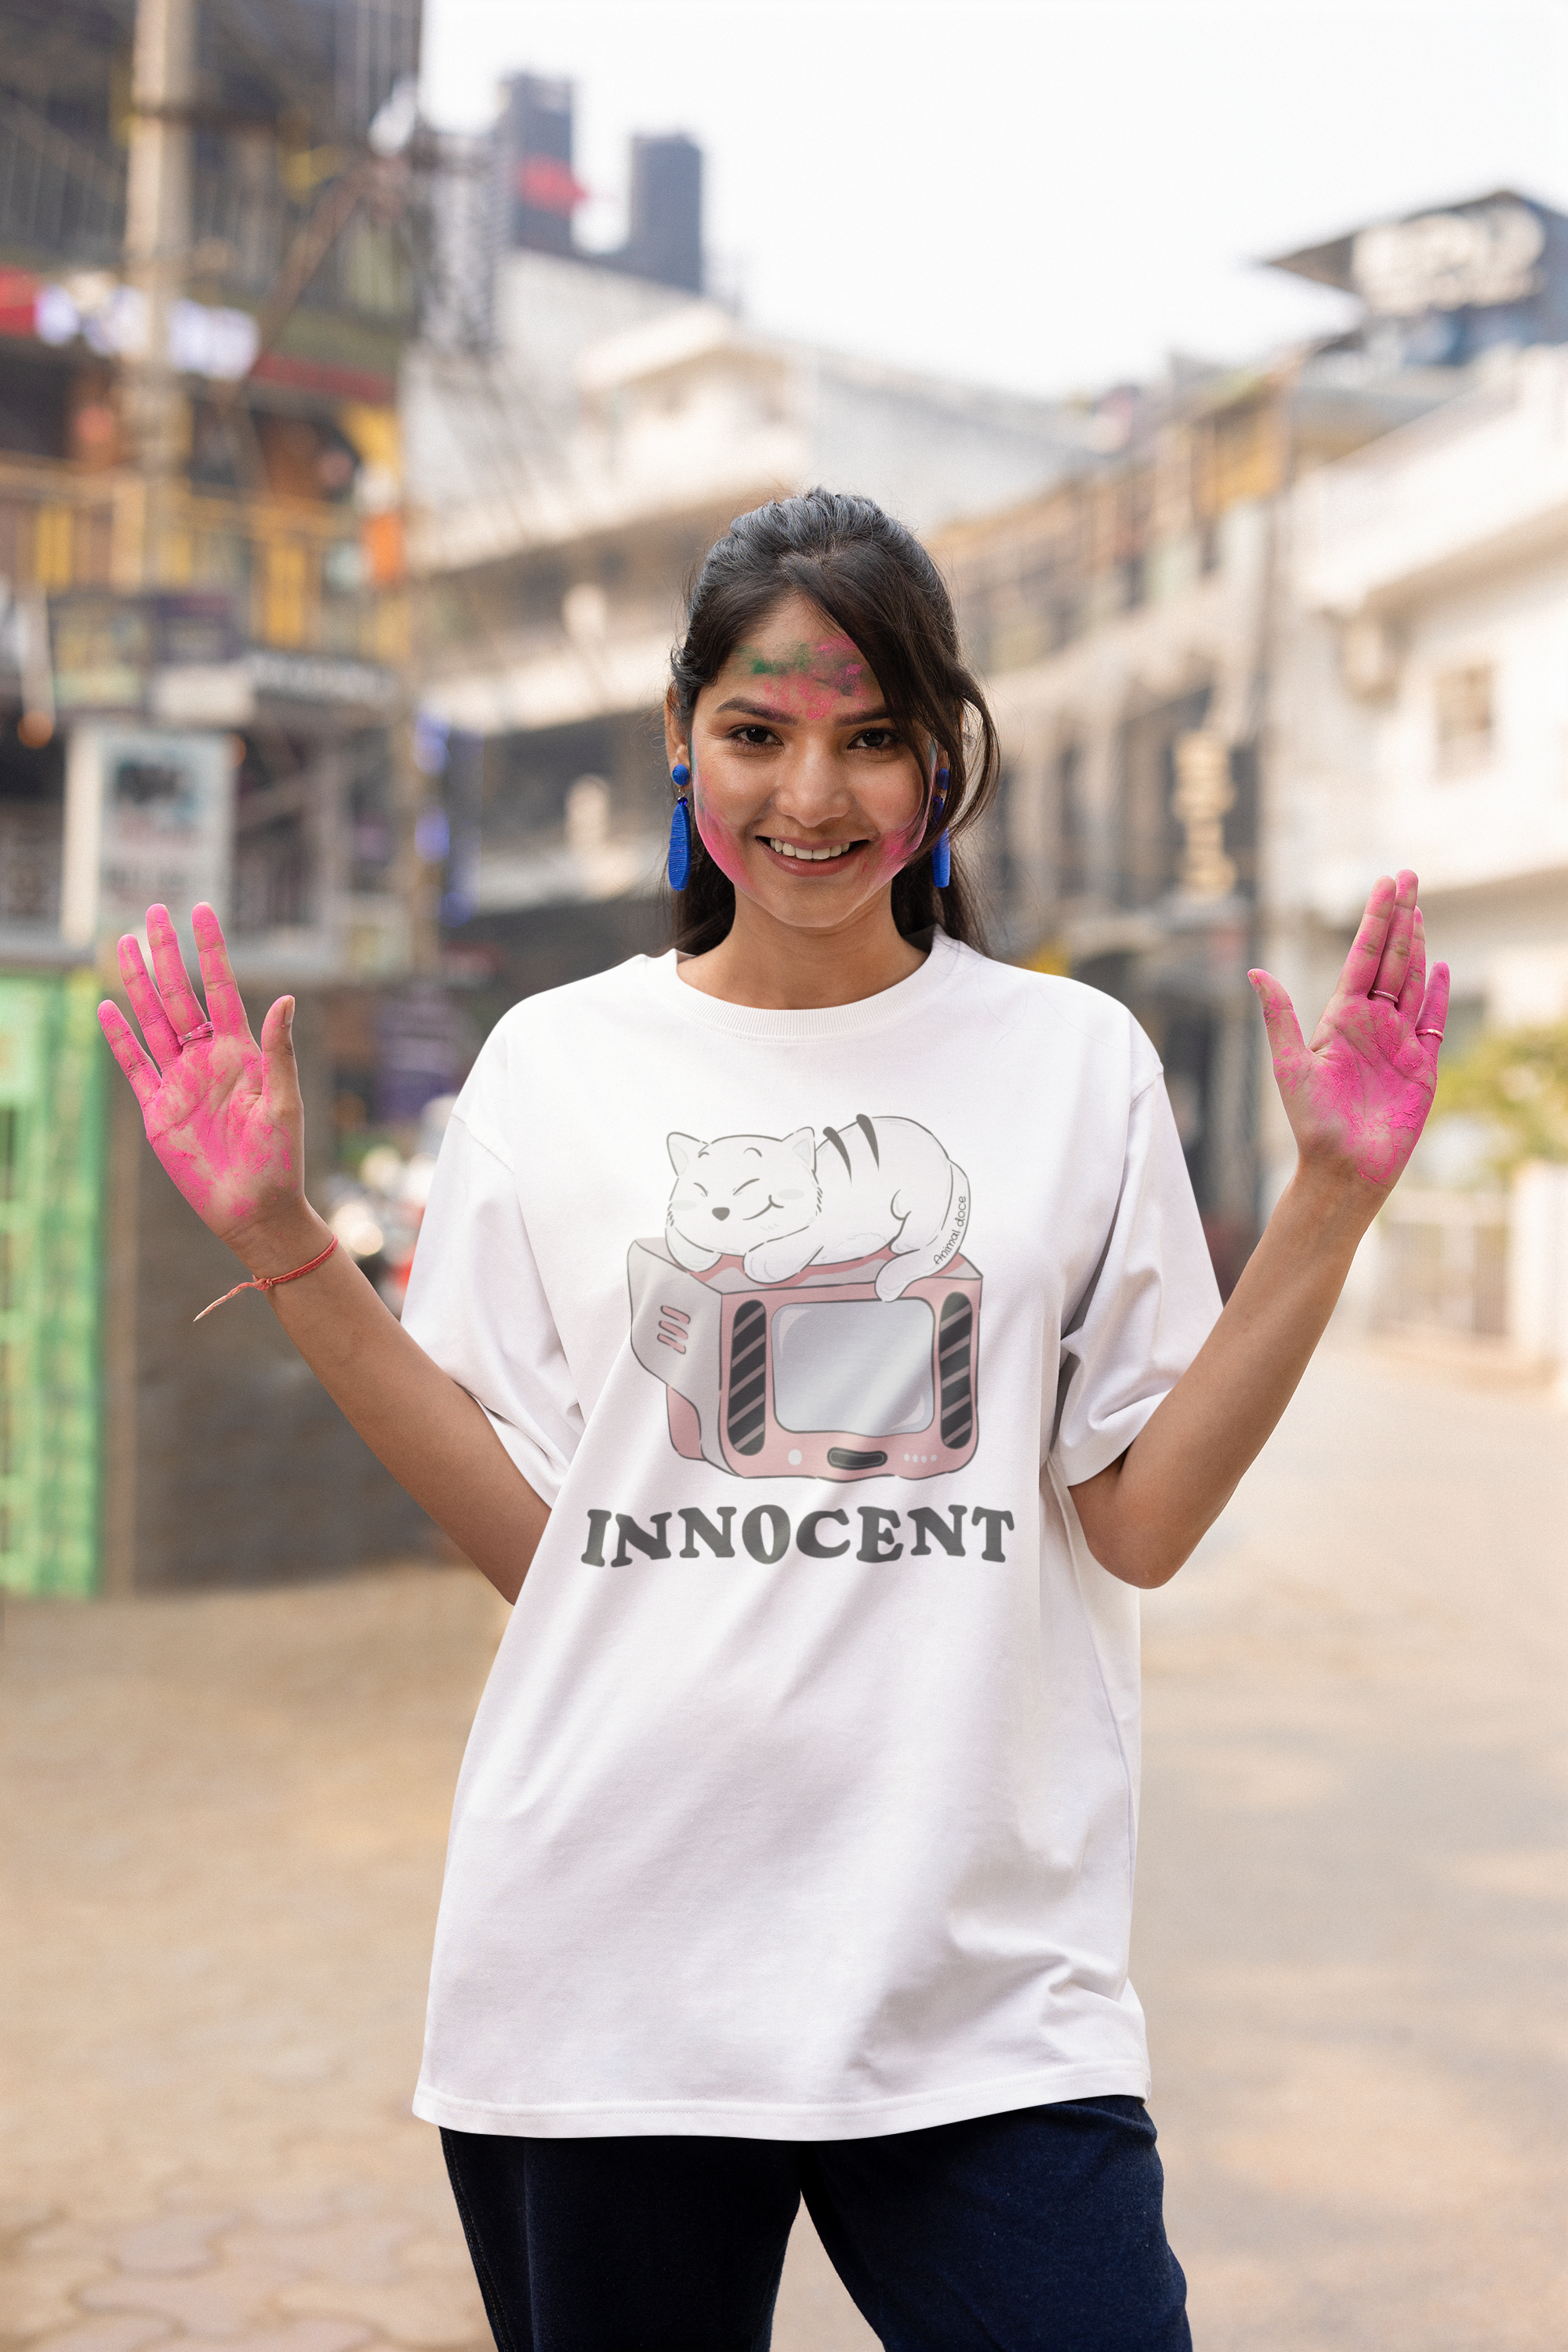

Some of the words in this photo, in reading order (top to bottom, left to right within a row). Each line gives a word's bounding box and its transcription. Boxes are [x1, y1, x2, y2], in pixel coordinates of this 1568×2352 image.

[933, 1229, 960, 1265] Animal
[954, 1196, 967, 1227] doce
[581, 1504, 1014, 1567] INNOCENT
